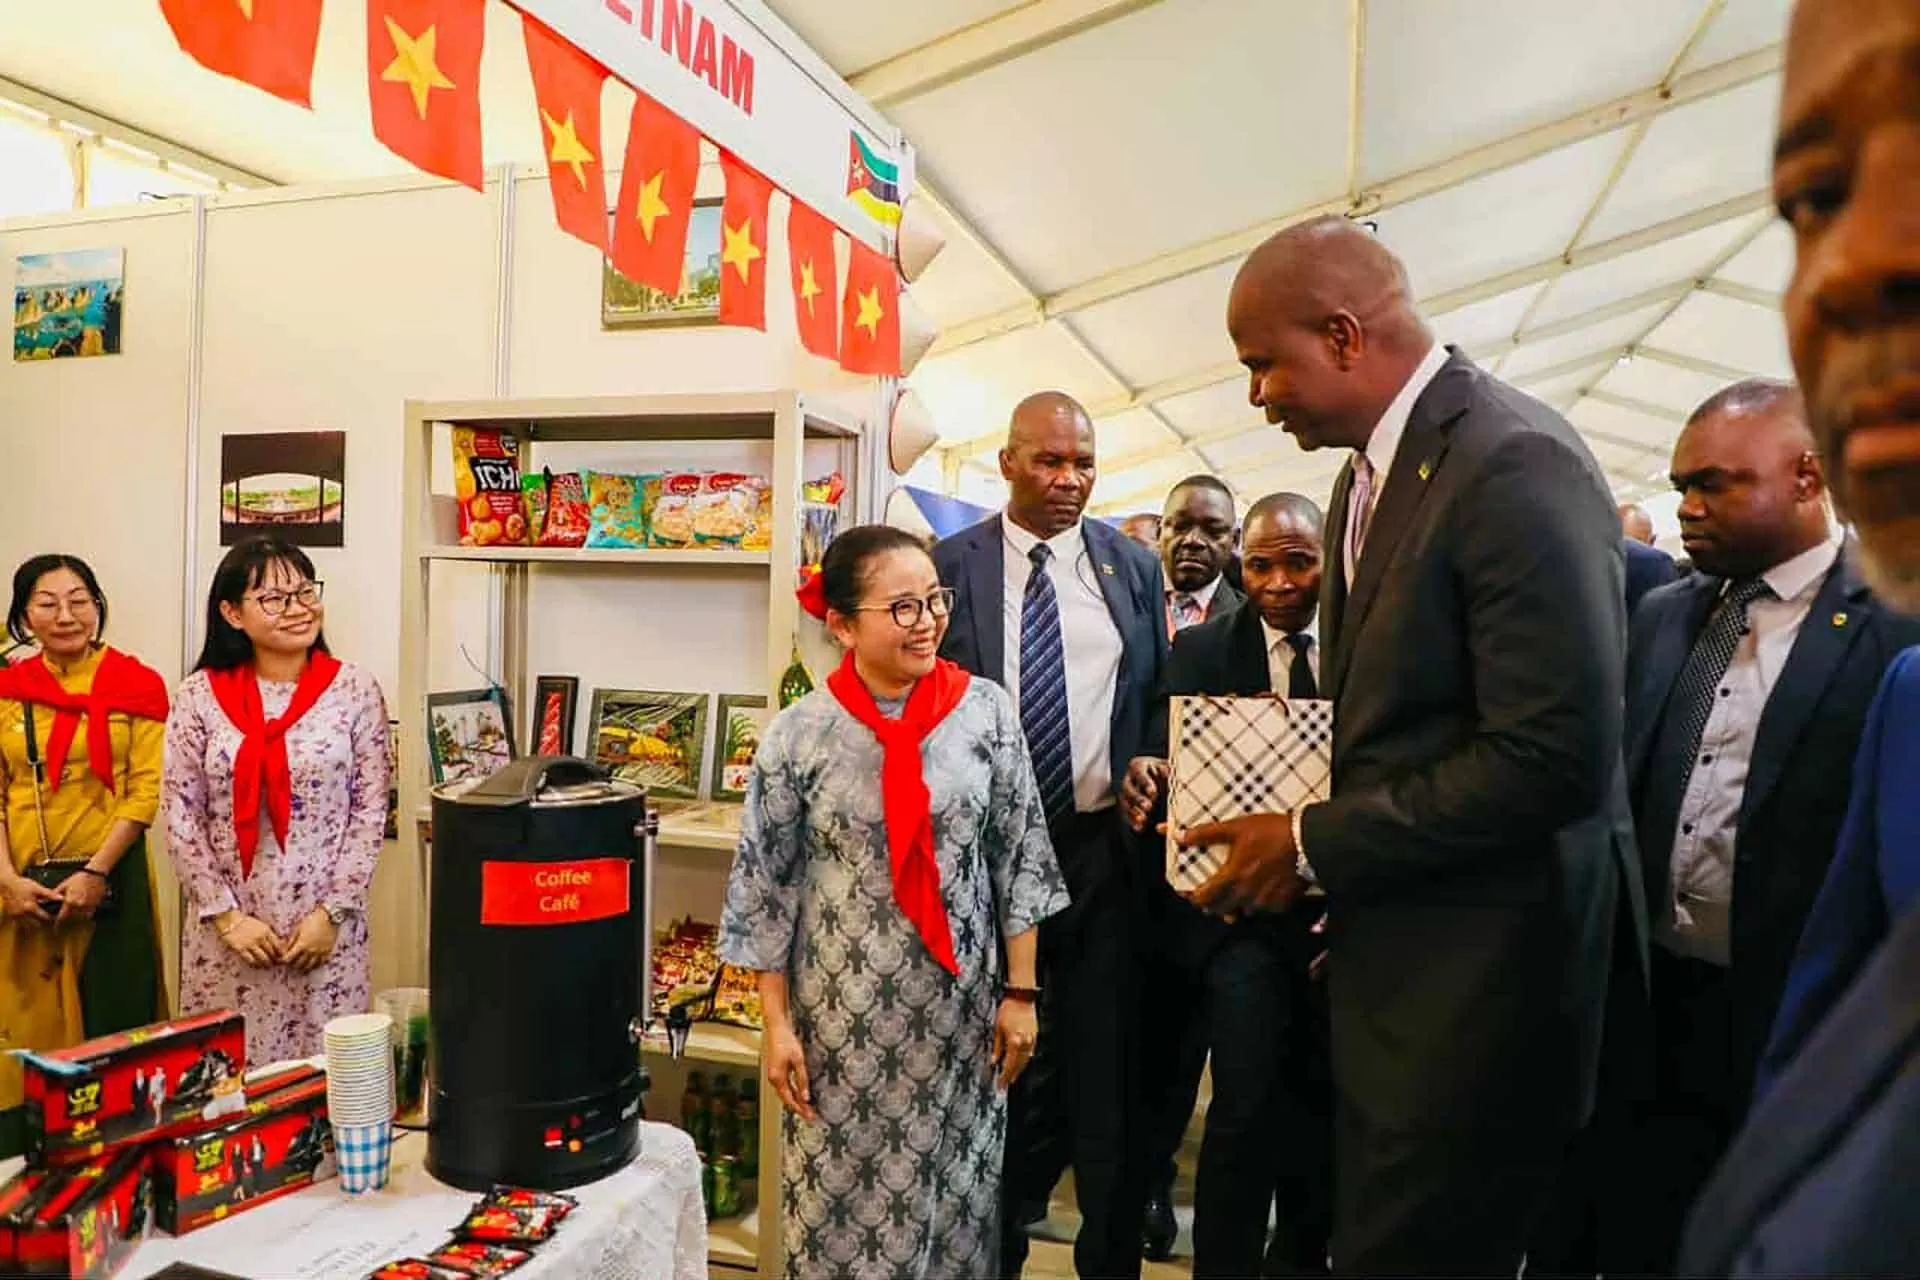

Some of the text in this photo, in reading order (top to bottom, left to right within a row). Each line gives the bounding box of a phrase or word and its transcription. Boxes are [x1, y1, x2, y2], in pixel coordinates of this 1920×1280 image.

[605, 0, 754, 116] NAM
[534, 869, 592, 887] Coffee
[539, 893, 580, 912] Café
